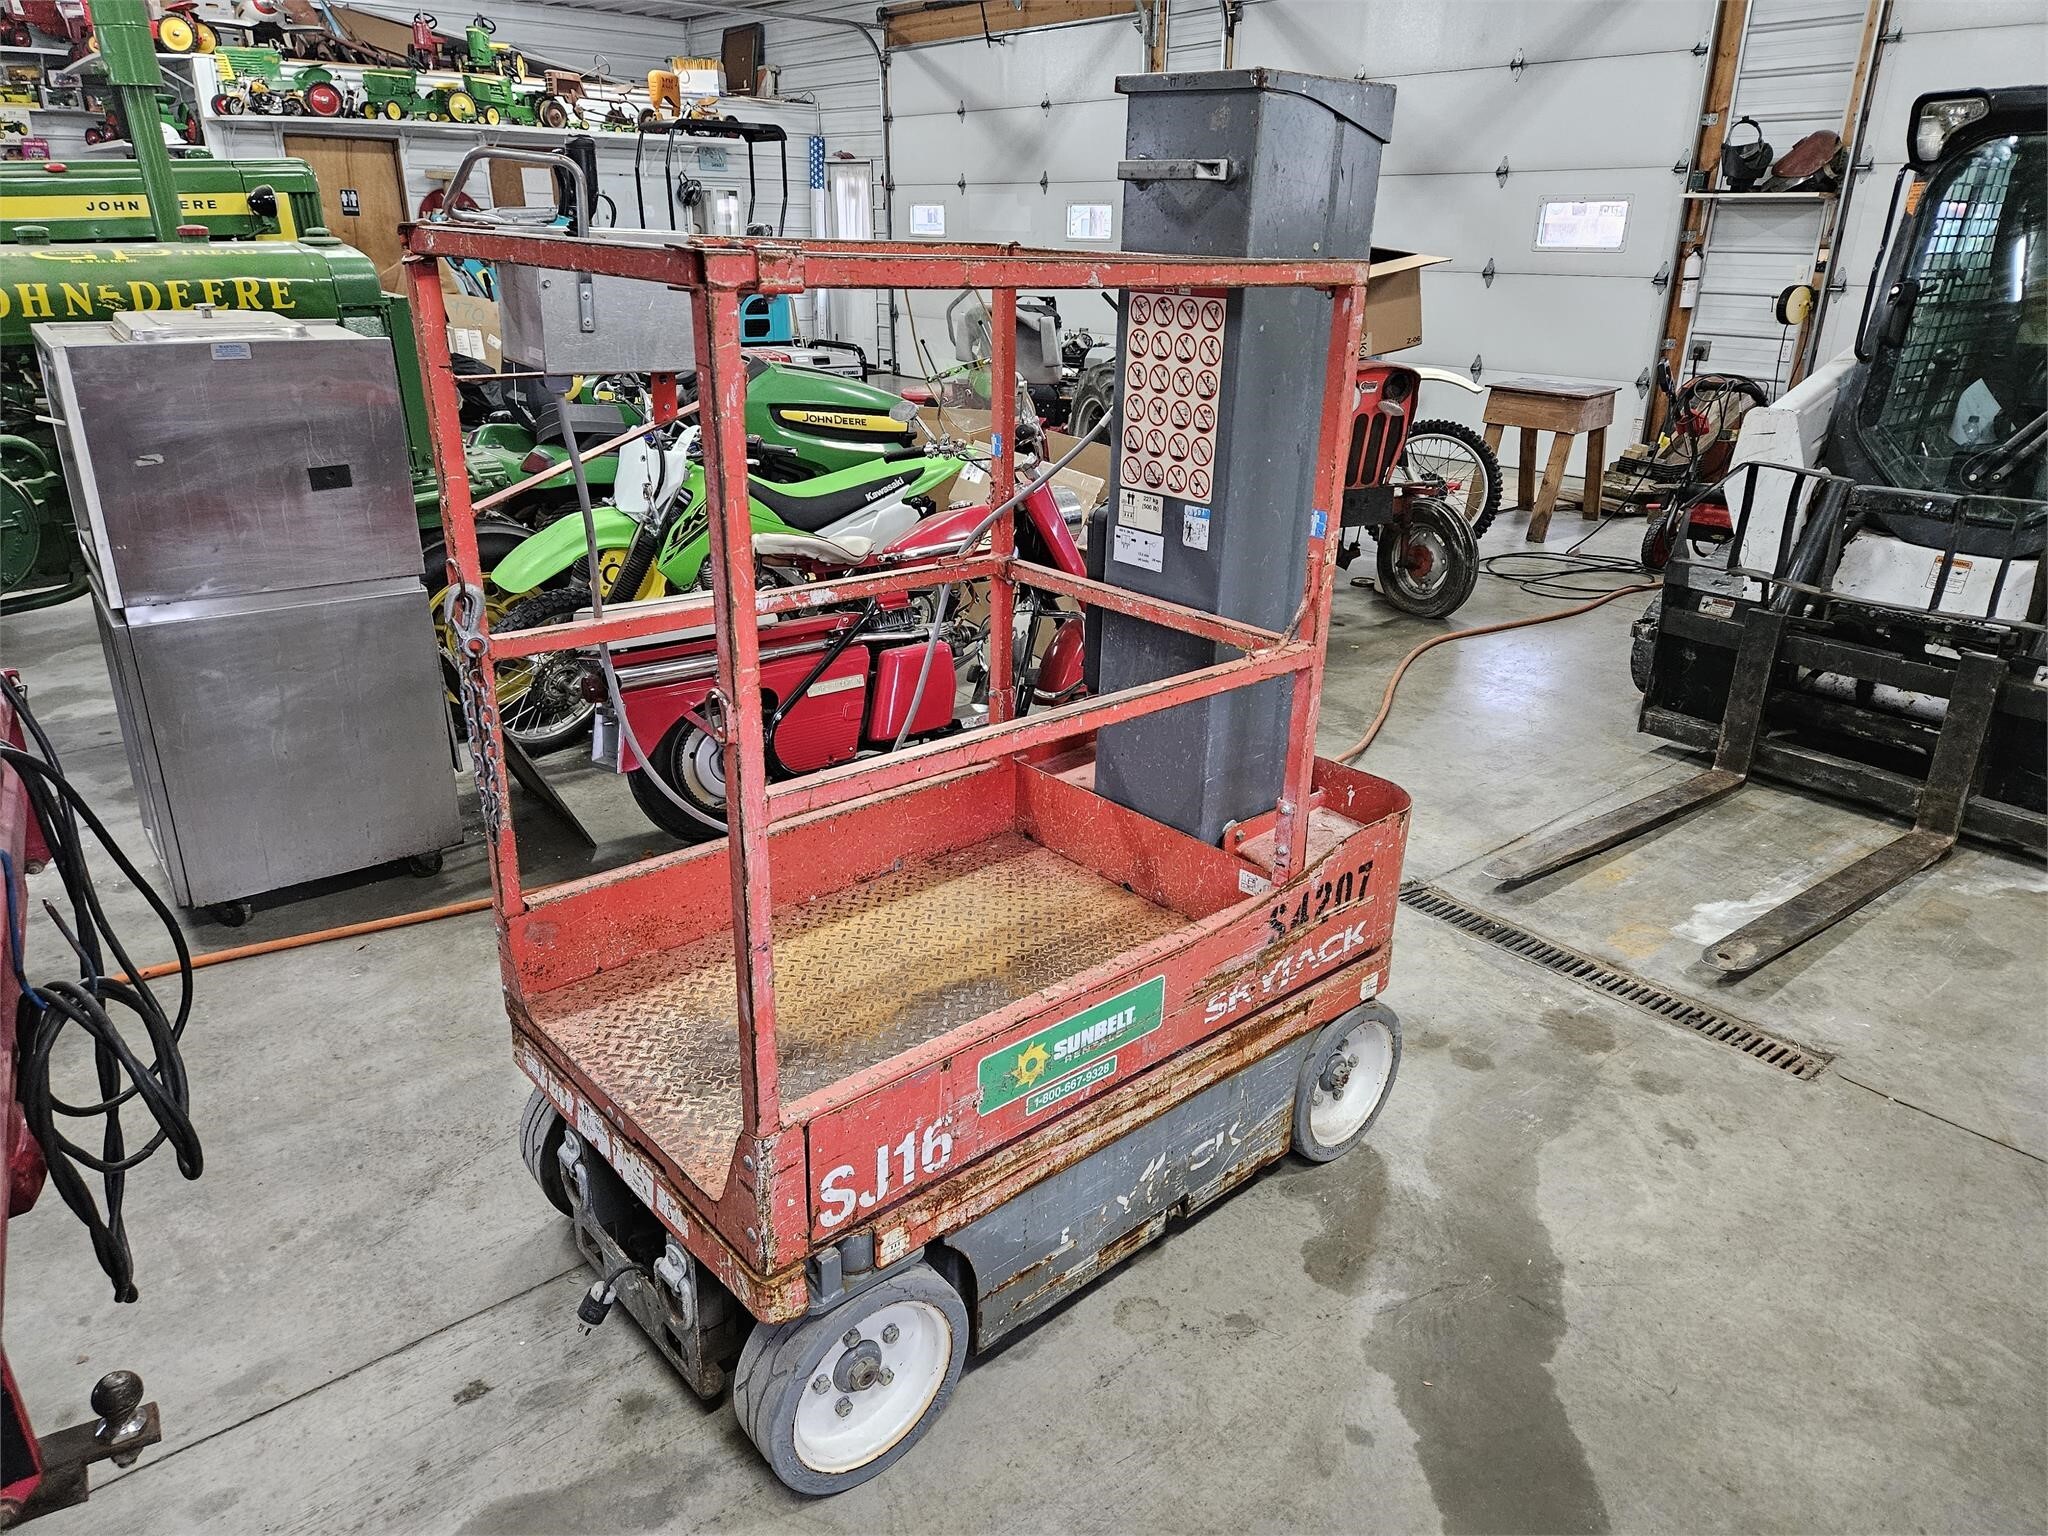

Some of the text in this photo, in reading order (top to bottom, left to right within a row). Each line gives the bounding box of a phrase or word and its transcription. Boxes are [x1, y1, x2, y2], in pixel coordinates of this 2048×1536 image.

[86, 200, 218, 211] JOHN ERE
[0, 277, 297, 319] HN DEERE
[802, 412, 867, 426] JOHN DEERE
[864, 476, 905, 502] Kawasaki
[1266, 860, 1374, 945] S4207
[1053, 1005, 1137, 1061] SUNBELT
[1034, 1062, 1110, 1109] 1-800-667-9328
[819, 1115, 954, 1228] SJ16
